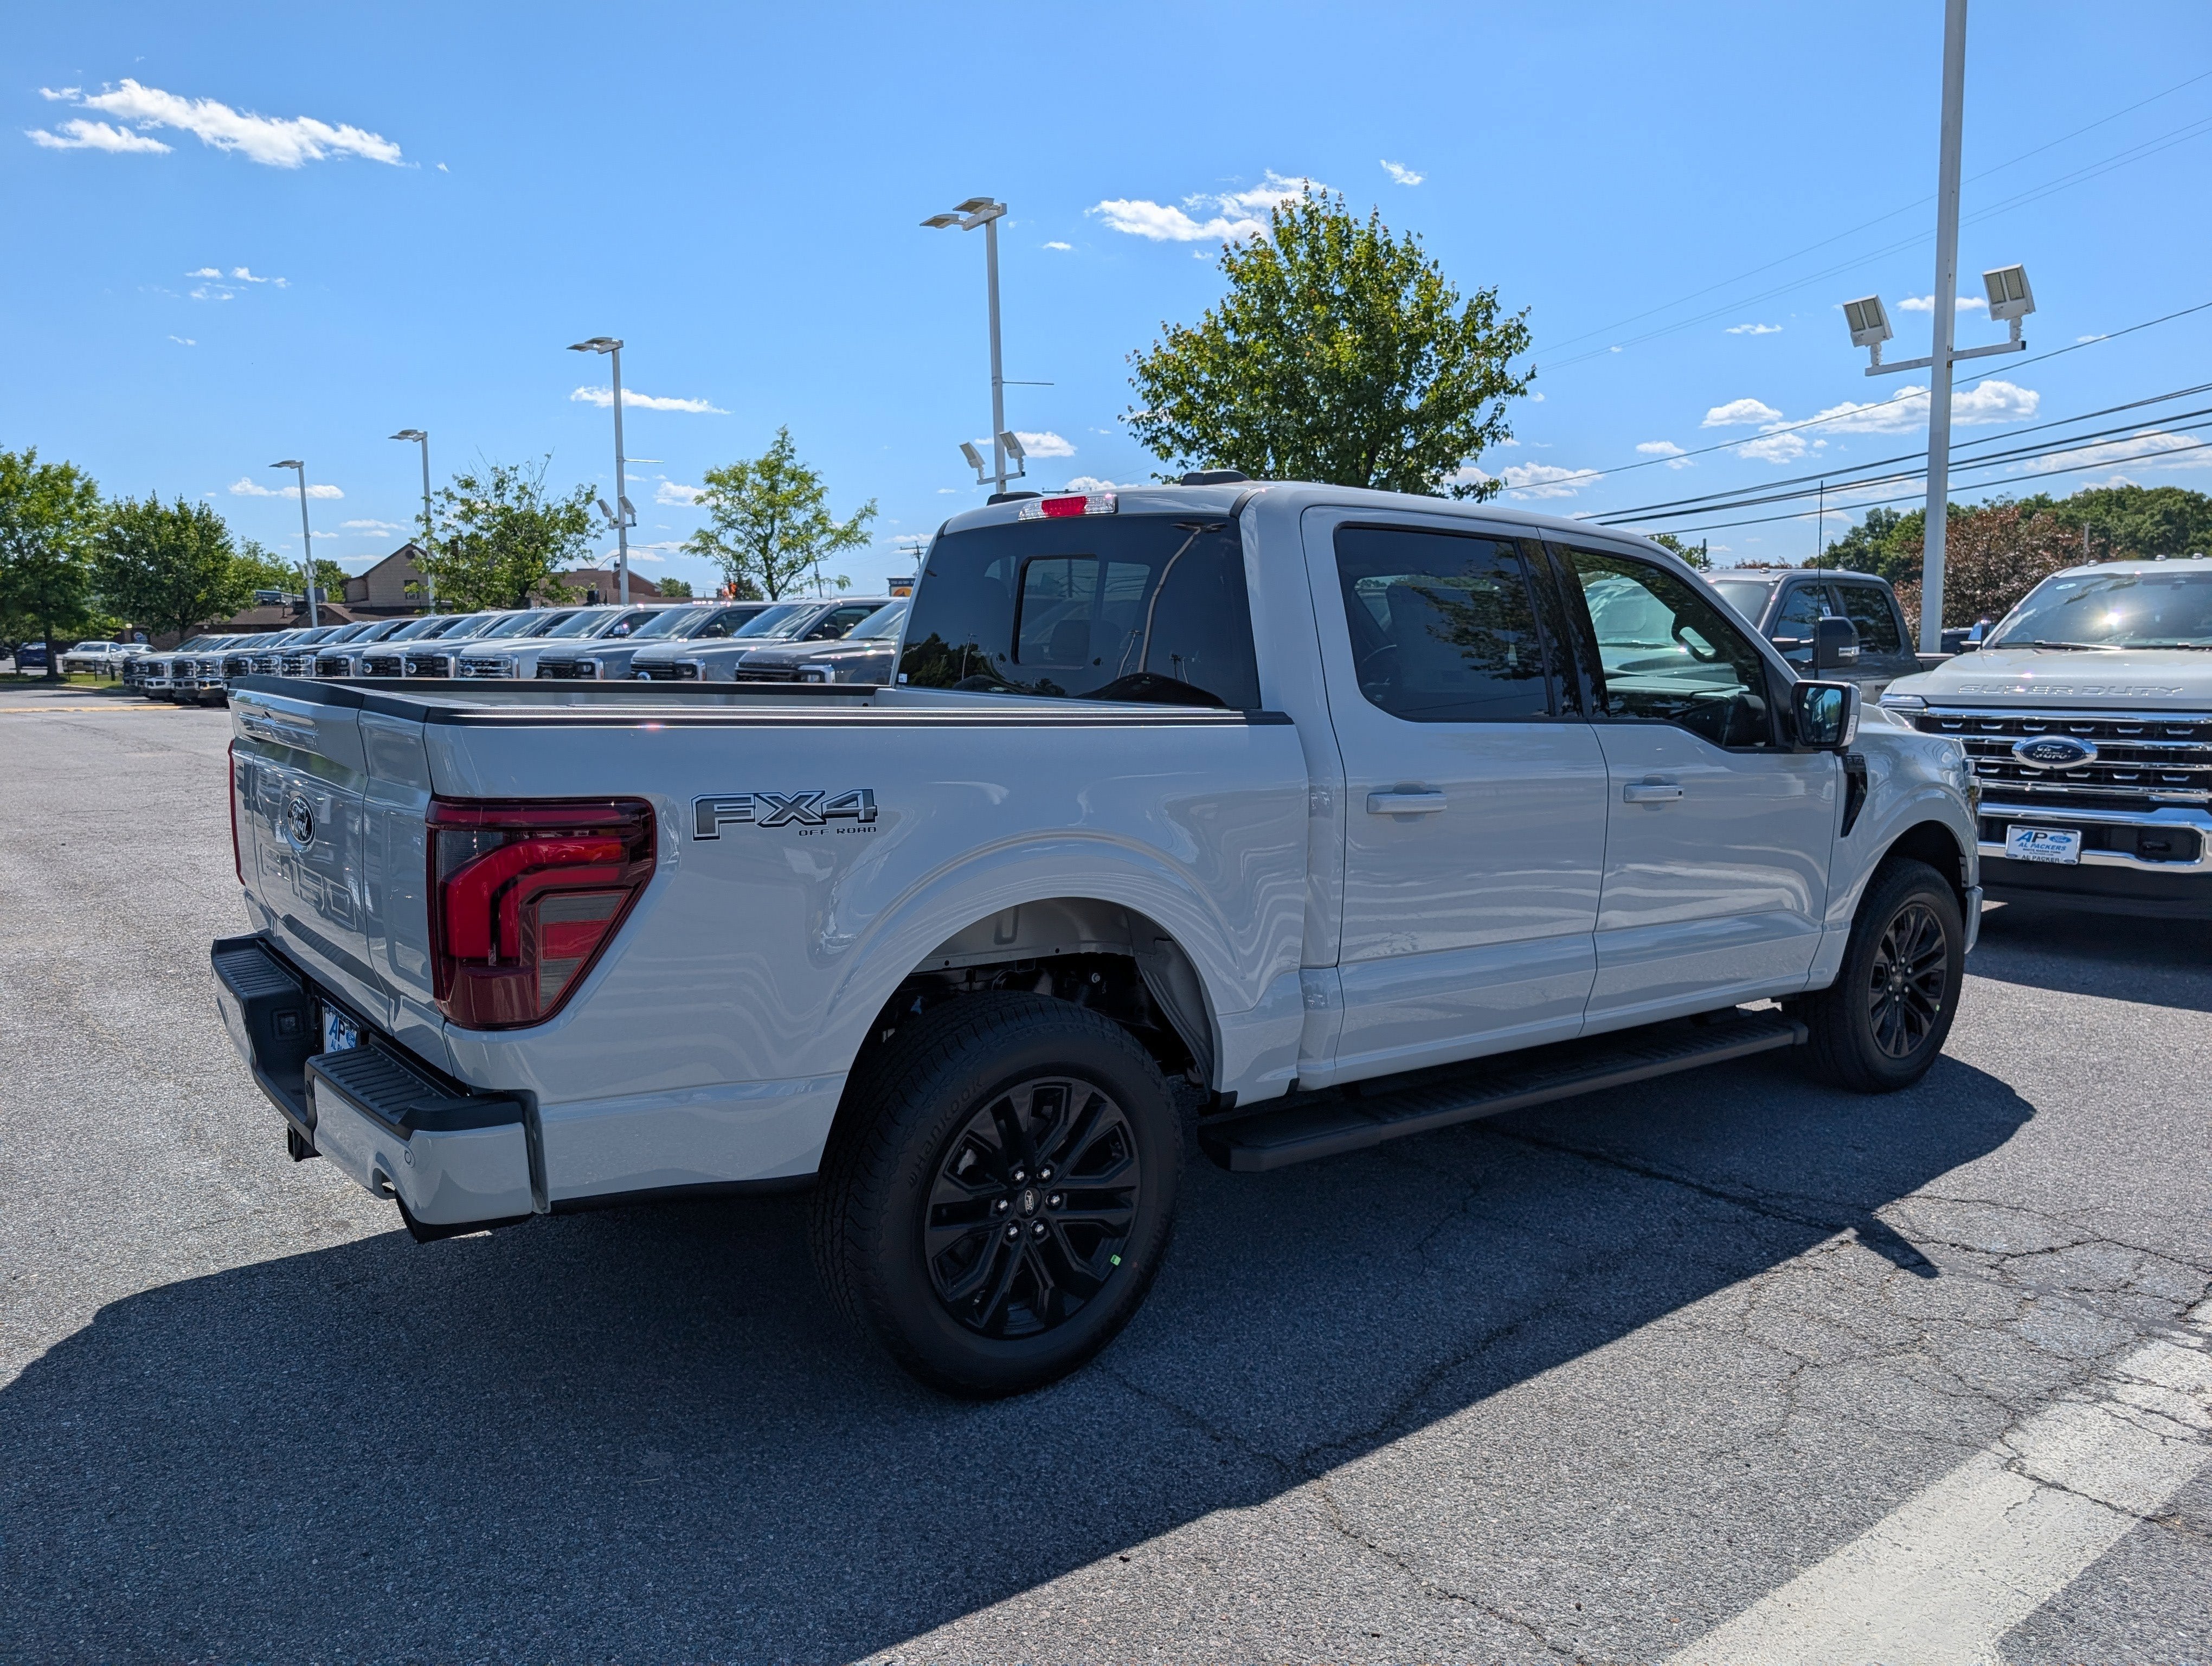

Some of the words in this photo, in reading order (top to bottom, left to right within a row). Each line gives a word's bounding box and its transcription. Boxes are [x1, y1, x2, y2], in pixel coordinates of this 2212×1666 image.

[1958, 683, 2074, 695] SUPER
[2080, 685, 2184, 697] DUTY
[2032, 744, 2072, 759] Ford
[290, 803, 308, 838] Ford
[691, 788, 879, 842] FX4
[836, 826, 877, 835] ROAD
[2015, 831, 2048, 842] AP
[329, 1015, 345, 1042] AP
